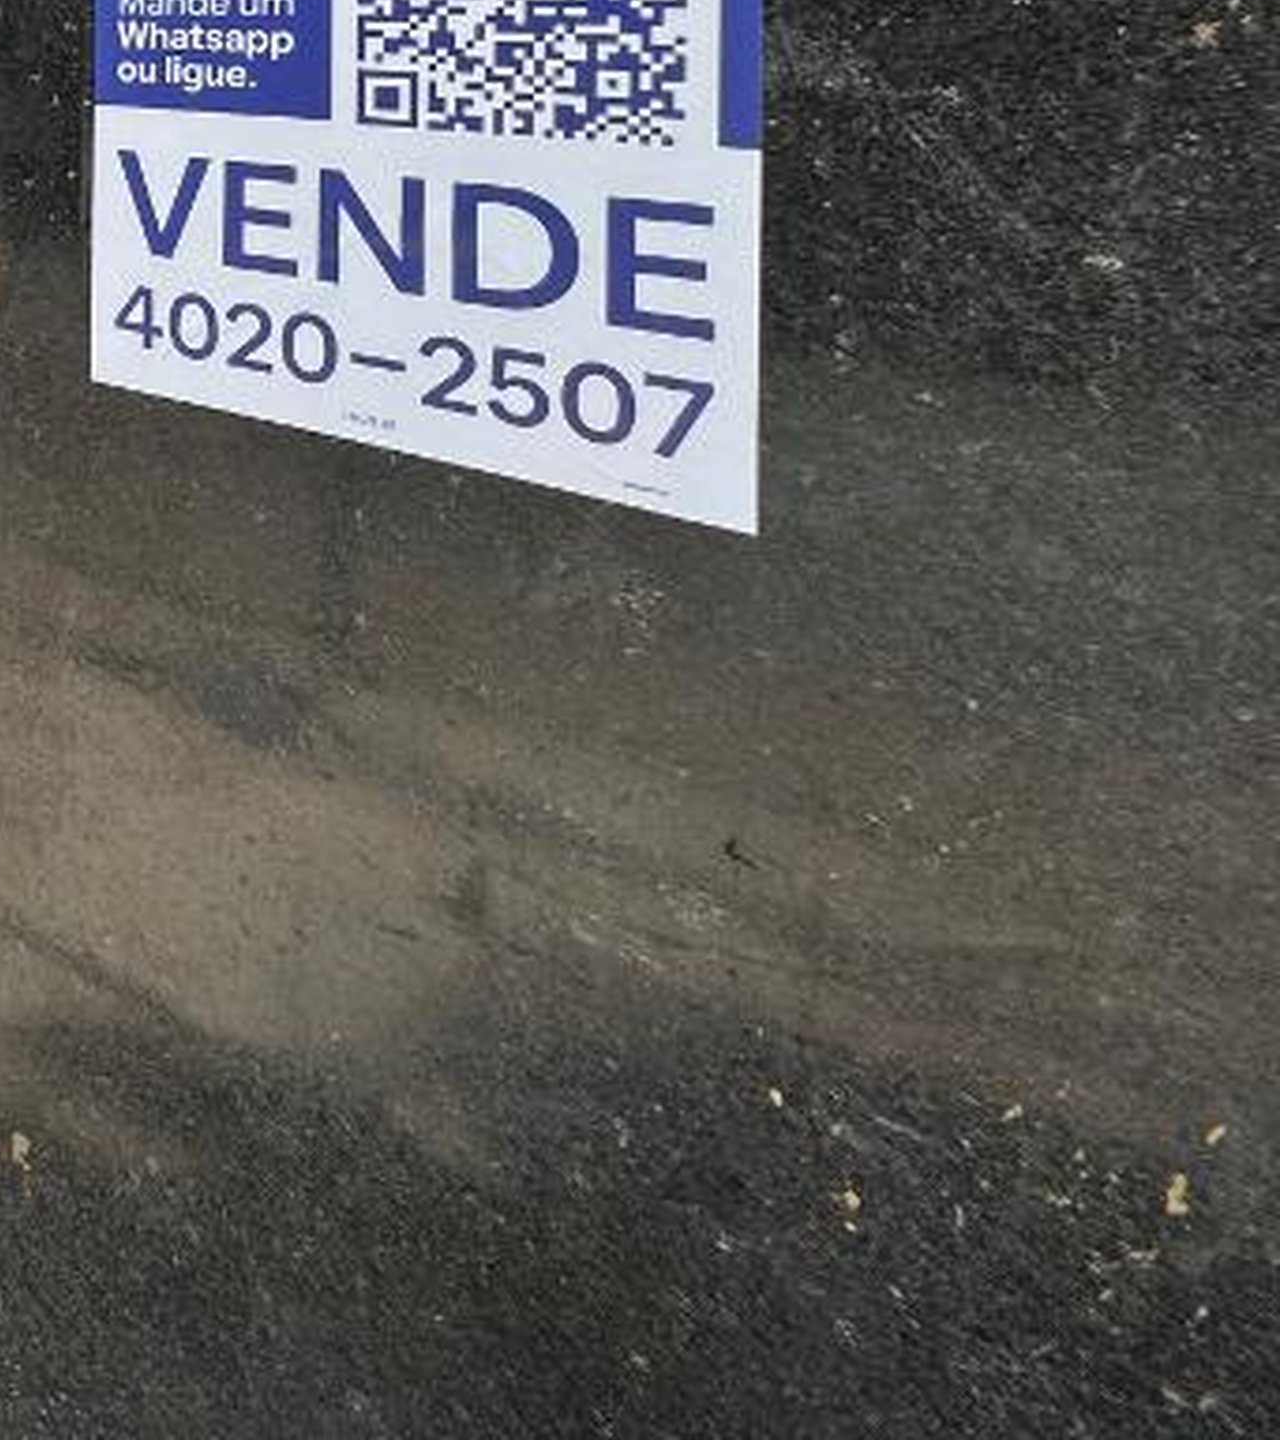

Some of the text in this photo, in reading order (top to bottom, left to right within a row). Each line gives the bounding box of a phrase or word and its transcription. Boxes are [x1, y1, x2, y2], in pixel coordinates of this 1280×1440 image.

[117, 20, 296, 61] Whatsapp
[117, 56, 258, 93] ou ligue.
[117, 148, 716, 343] VENDE
[113, 284, 716, 460] 4020-2507
